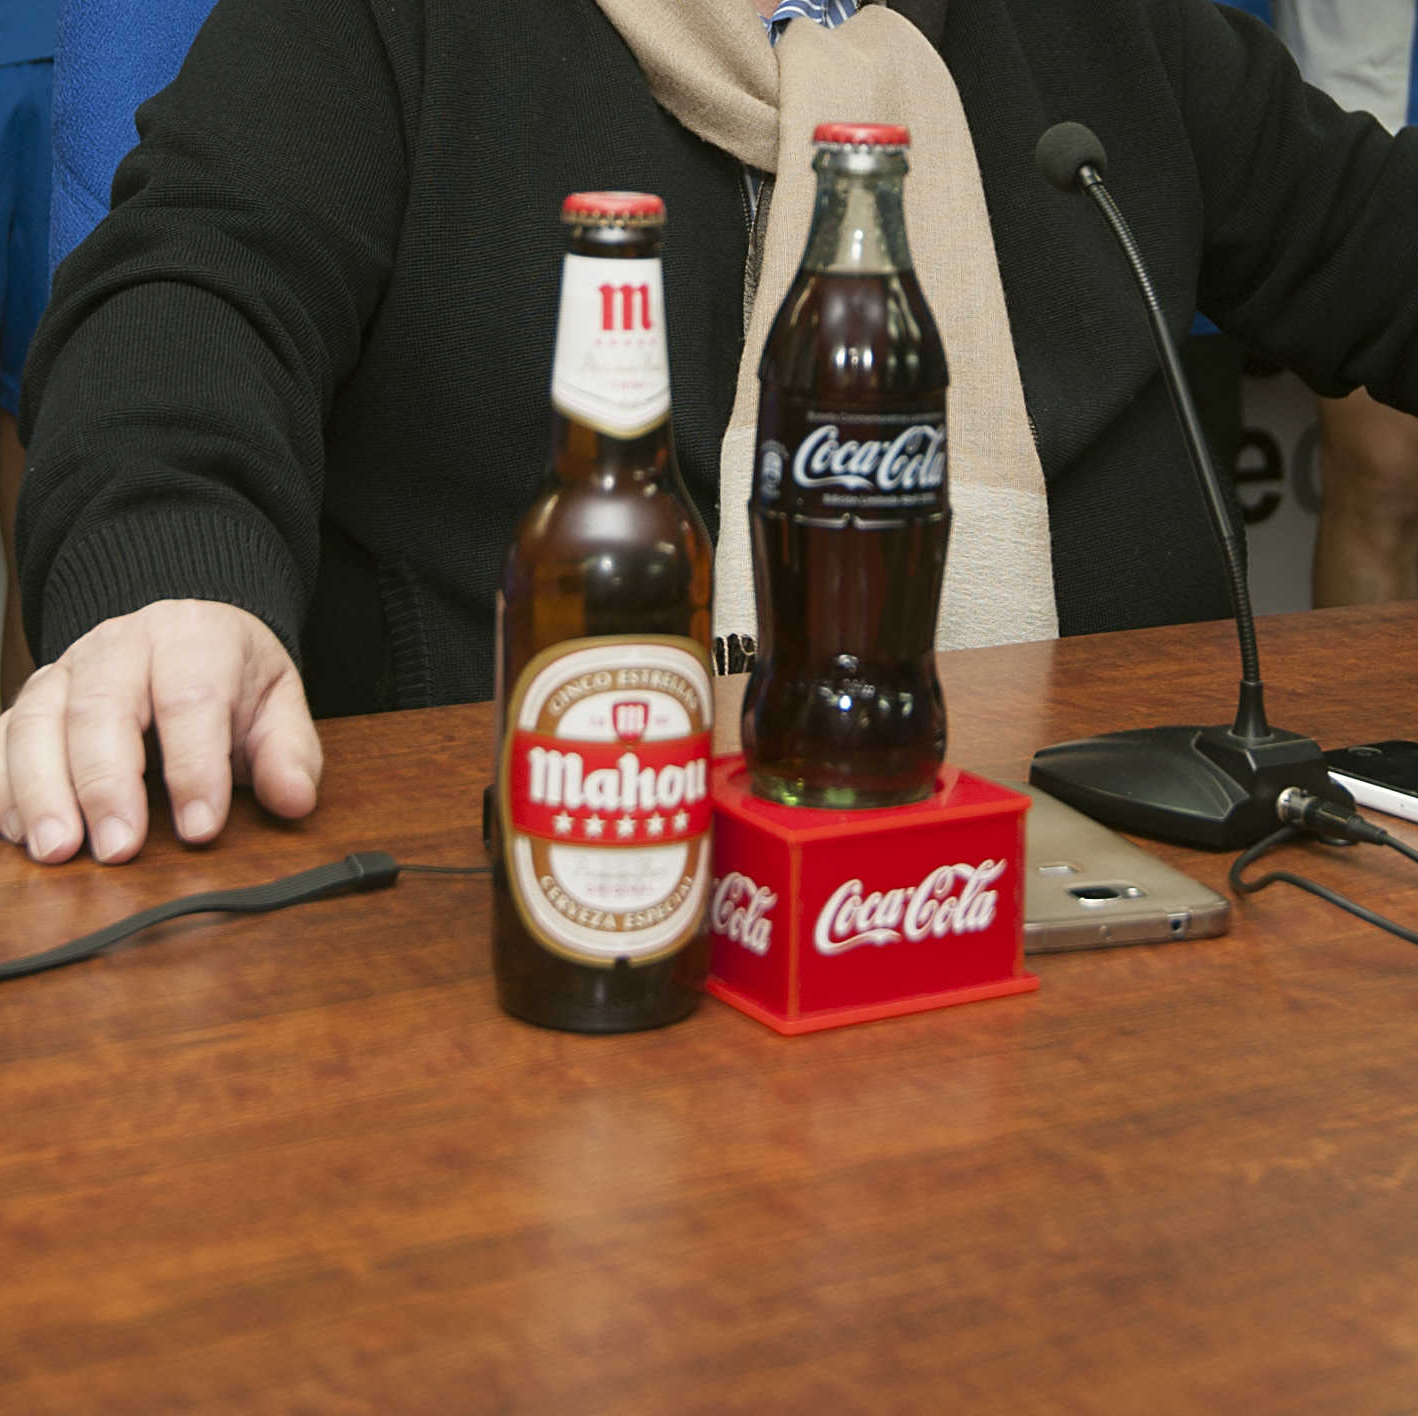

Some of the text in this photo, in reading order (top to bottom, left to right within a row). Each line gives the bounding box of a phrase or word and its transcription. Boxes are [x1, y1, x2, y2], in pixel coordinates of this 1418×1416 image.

[548, 670, 614, 715] CINCO
[528, 745, 707, 812] Mahou
[813, 858, 1008, 957] Coca-Cola
